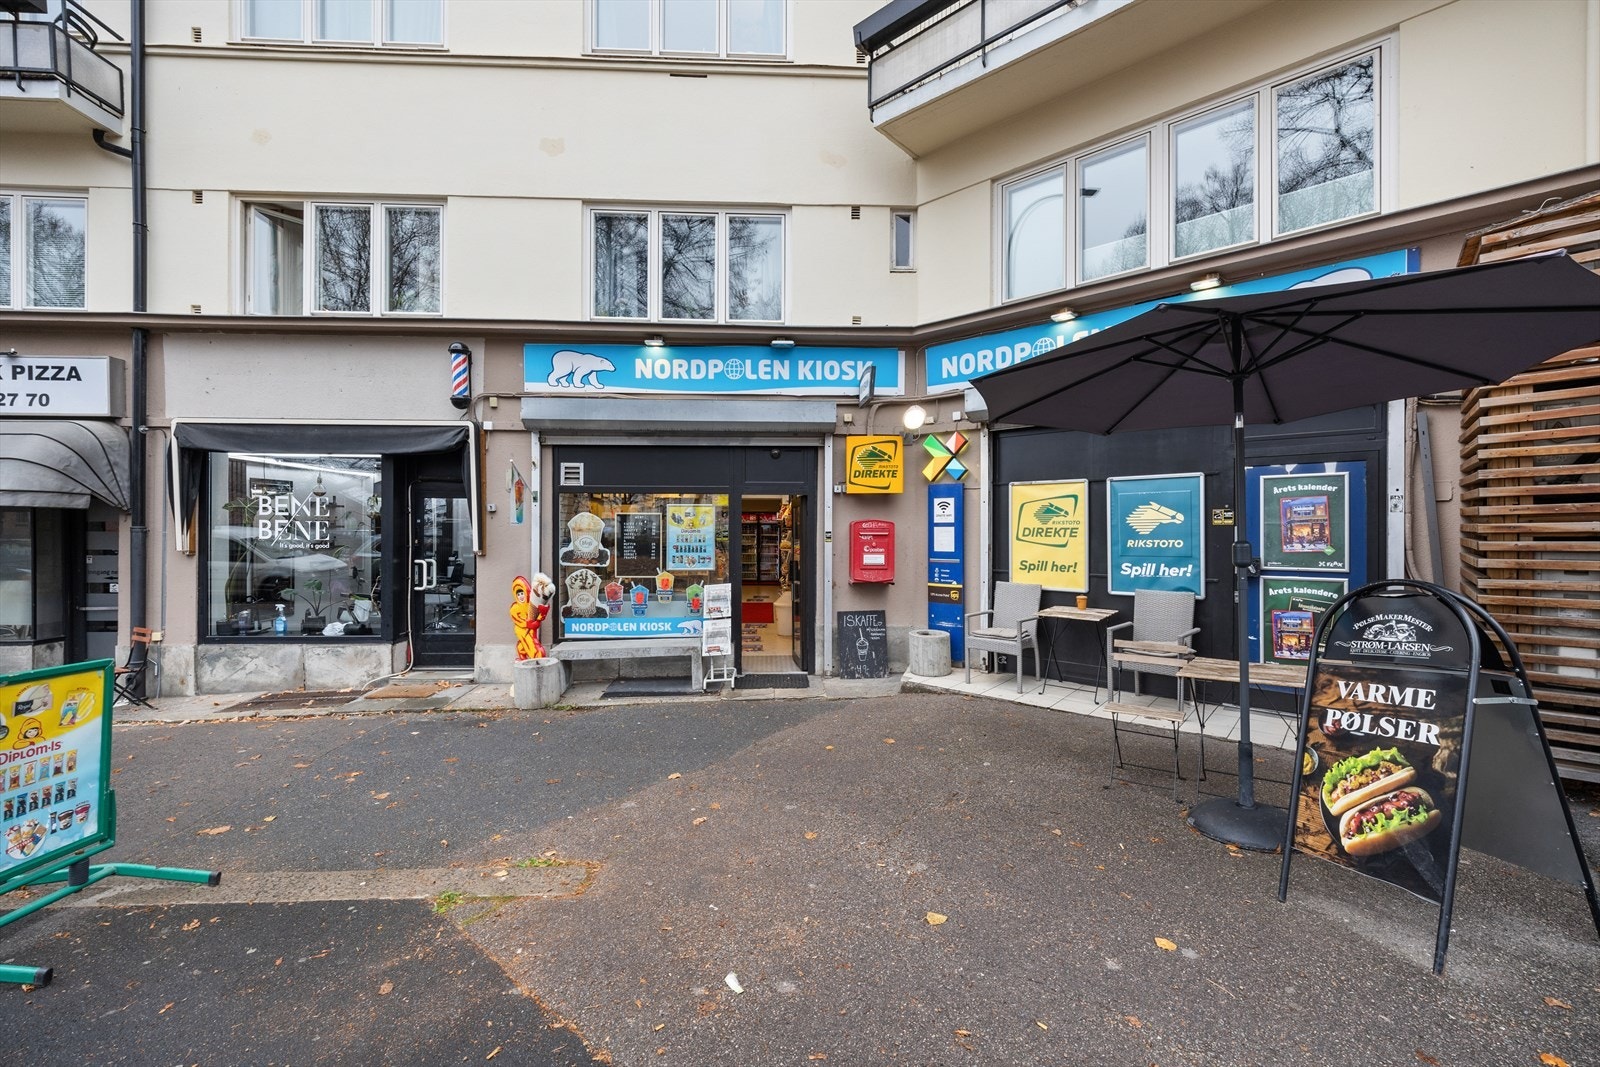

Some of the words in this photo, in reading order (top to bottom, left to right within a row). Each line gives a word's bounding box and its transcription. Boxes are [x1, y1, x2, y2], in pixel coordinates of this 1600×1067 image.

[12, 365, 82, 381] PIZZA
[635, 357, 790, 382] NORDPOLEN
[26, 393, 50, 407] 70
[853, 469, 898, 479] DIREKTE
[1298, 483, 1338, 492] kalender
[258, 495, 330, 517] BENE
[258, 519, 330, 541] BENE
[1022, 527, 1079, 538] DIREKTE
[1127, 539, 1184, 548] RIKSTOTO
[1019, 560, 1048, 573] Spill
[1051, 561, 1078, 573] her!
[1120, 562, 1156, 578] Spill
[1159, 563, 1193, 577] her!
[1293, 586, 1339, 599] kalendere
[571, 622, 637, 632] NORDPOLEN
[640, 622, 672, 631] KIOSK
[843, 614, 879, 627] ISKAFFE
[1350, 641, 1431, 652] STRØM-LARSEN
[1337, 680, 1436, 711] VARME
[1324, 709, 1441, 746] PØLSER
